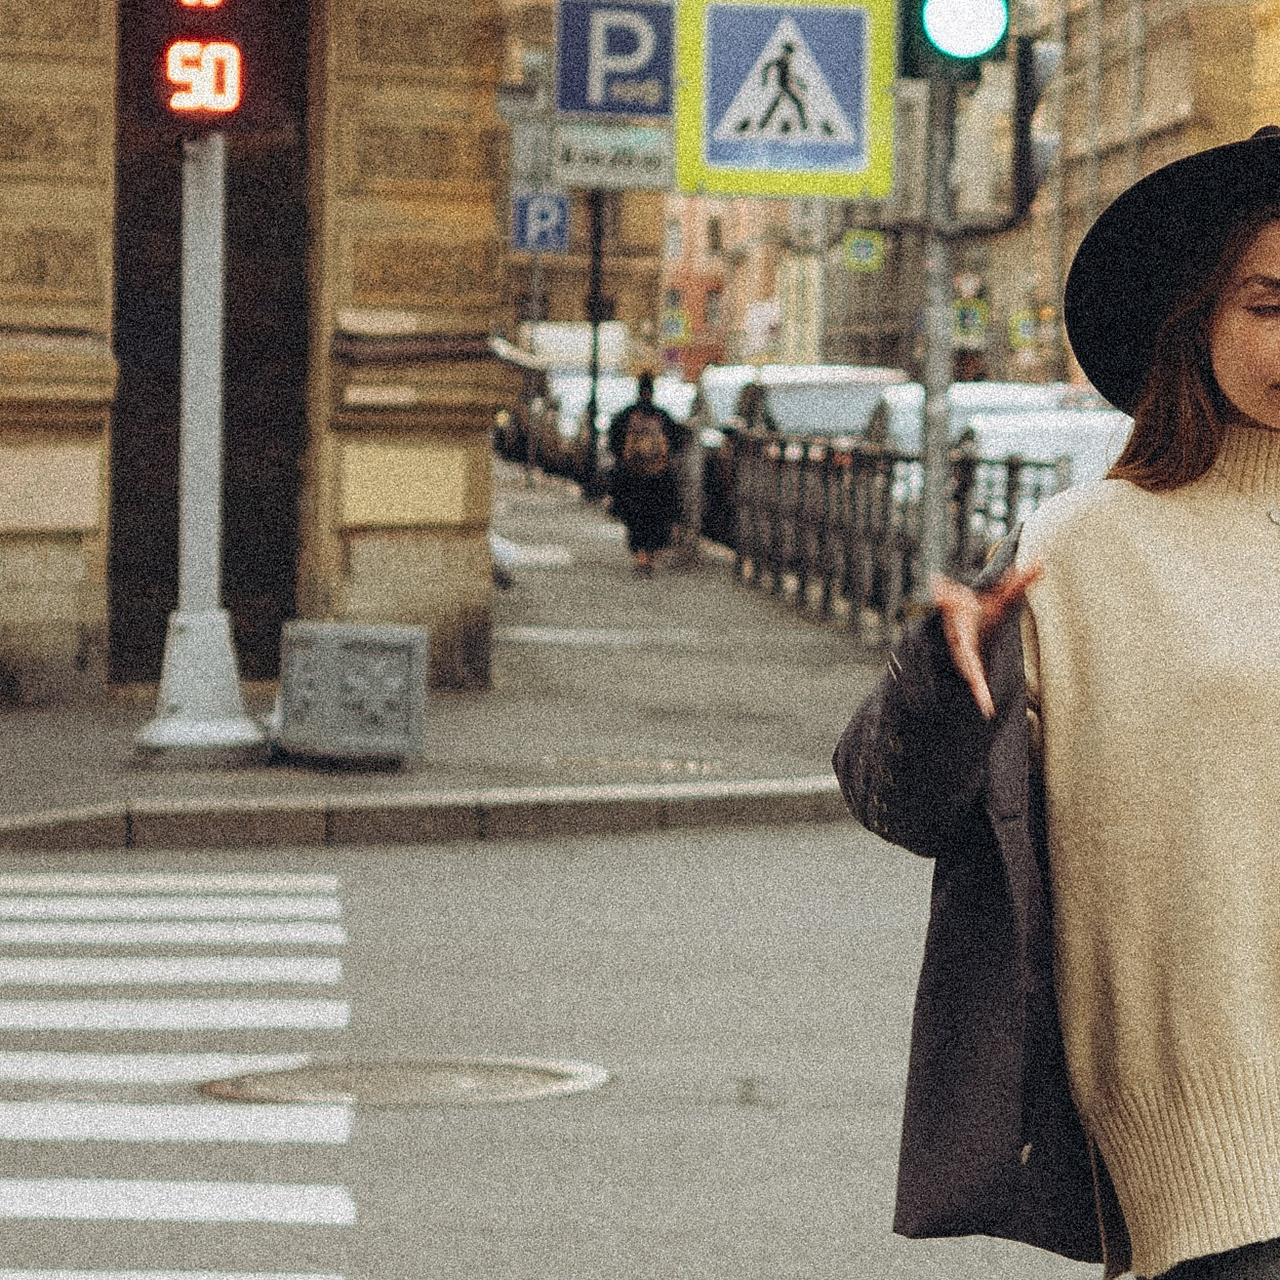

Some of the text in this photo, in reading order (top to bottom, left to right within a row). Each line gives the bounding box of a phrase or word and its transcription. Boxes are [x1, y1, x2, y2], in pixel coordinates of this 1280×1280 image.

[166, 40, 242, 112] 50
[588, 9, 657, 105] P
[528, 199, 559, 243] P
